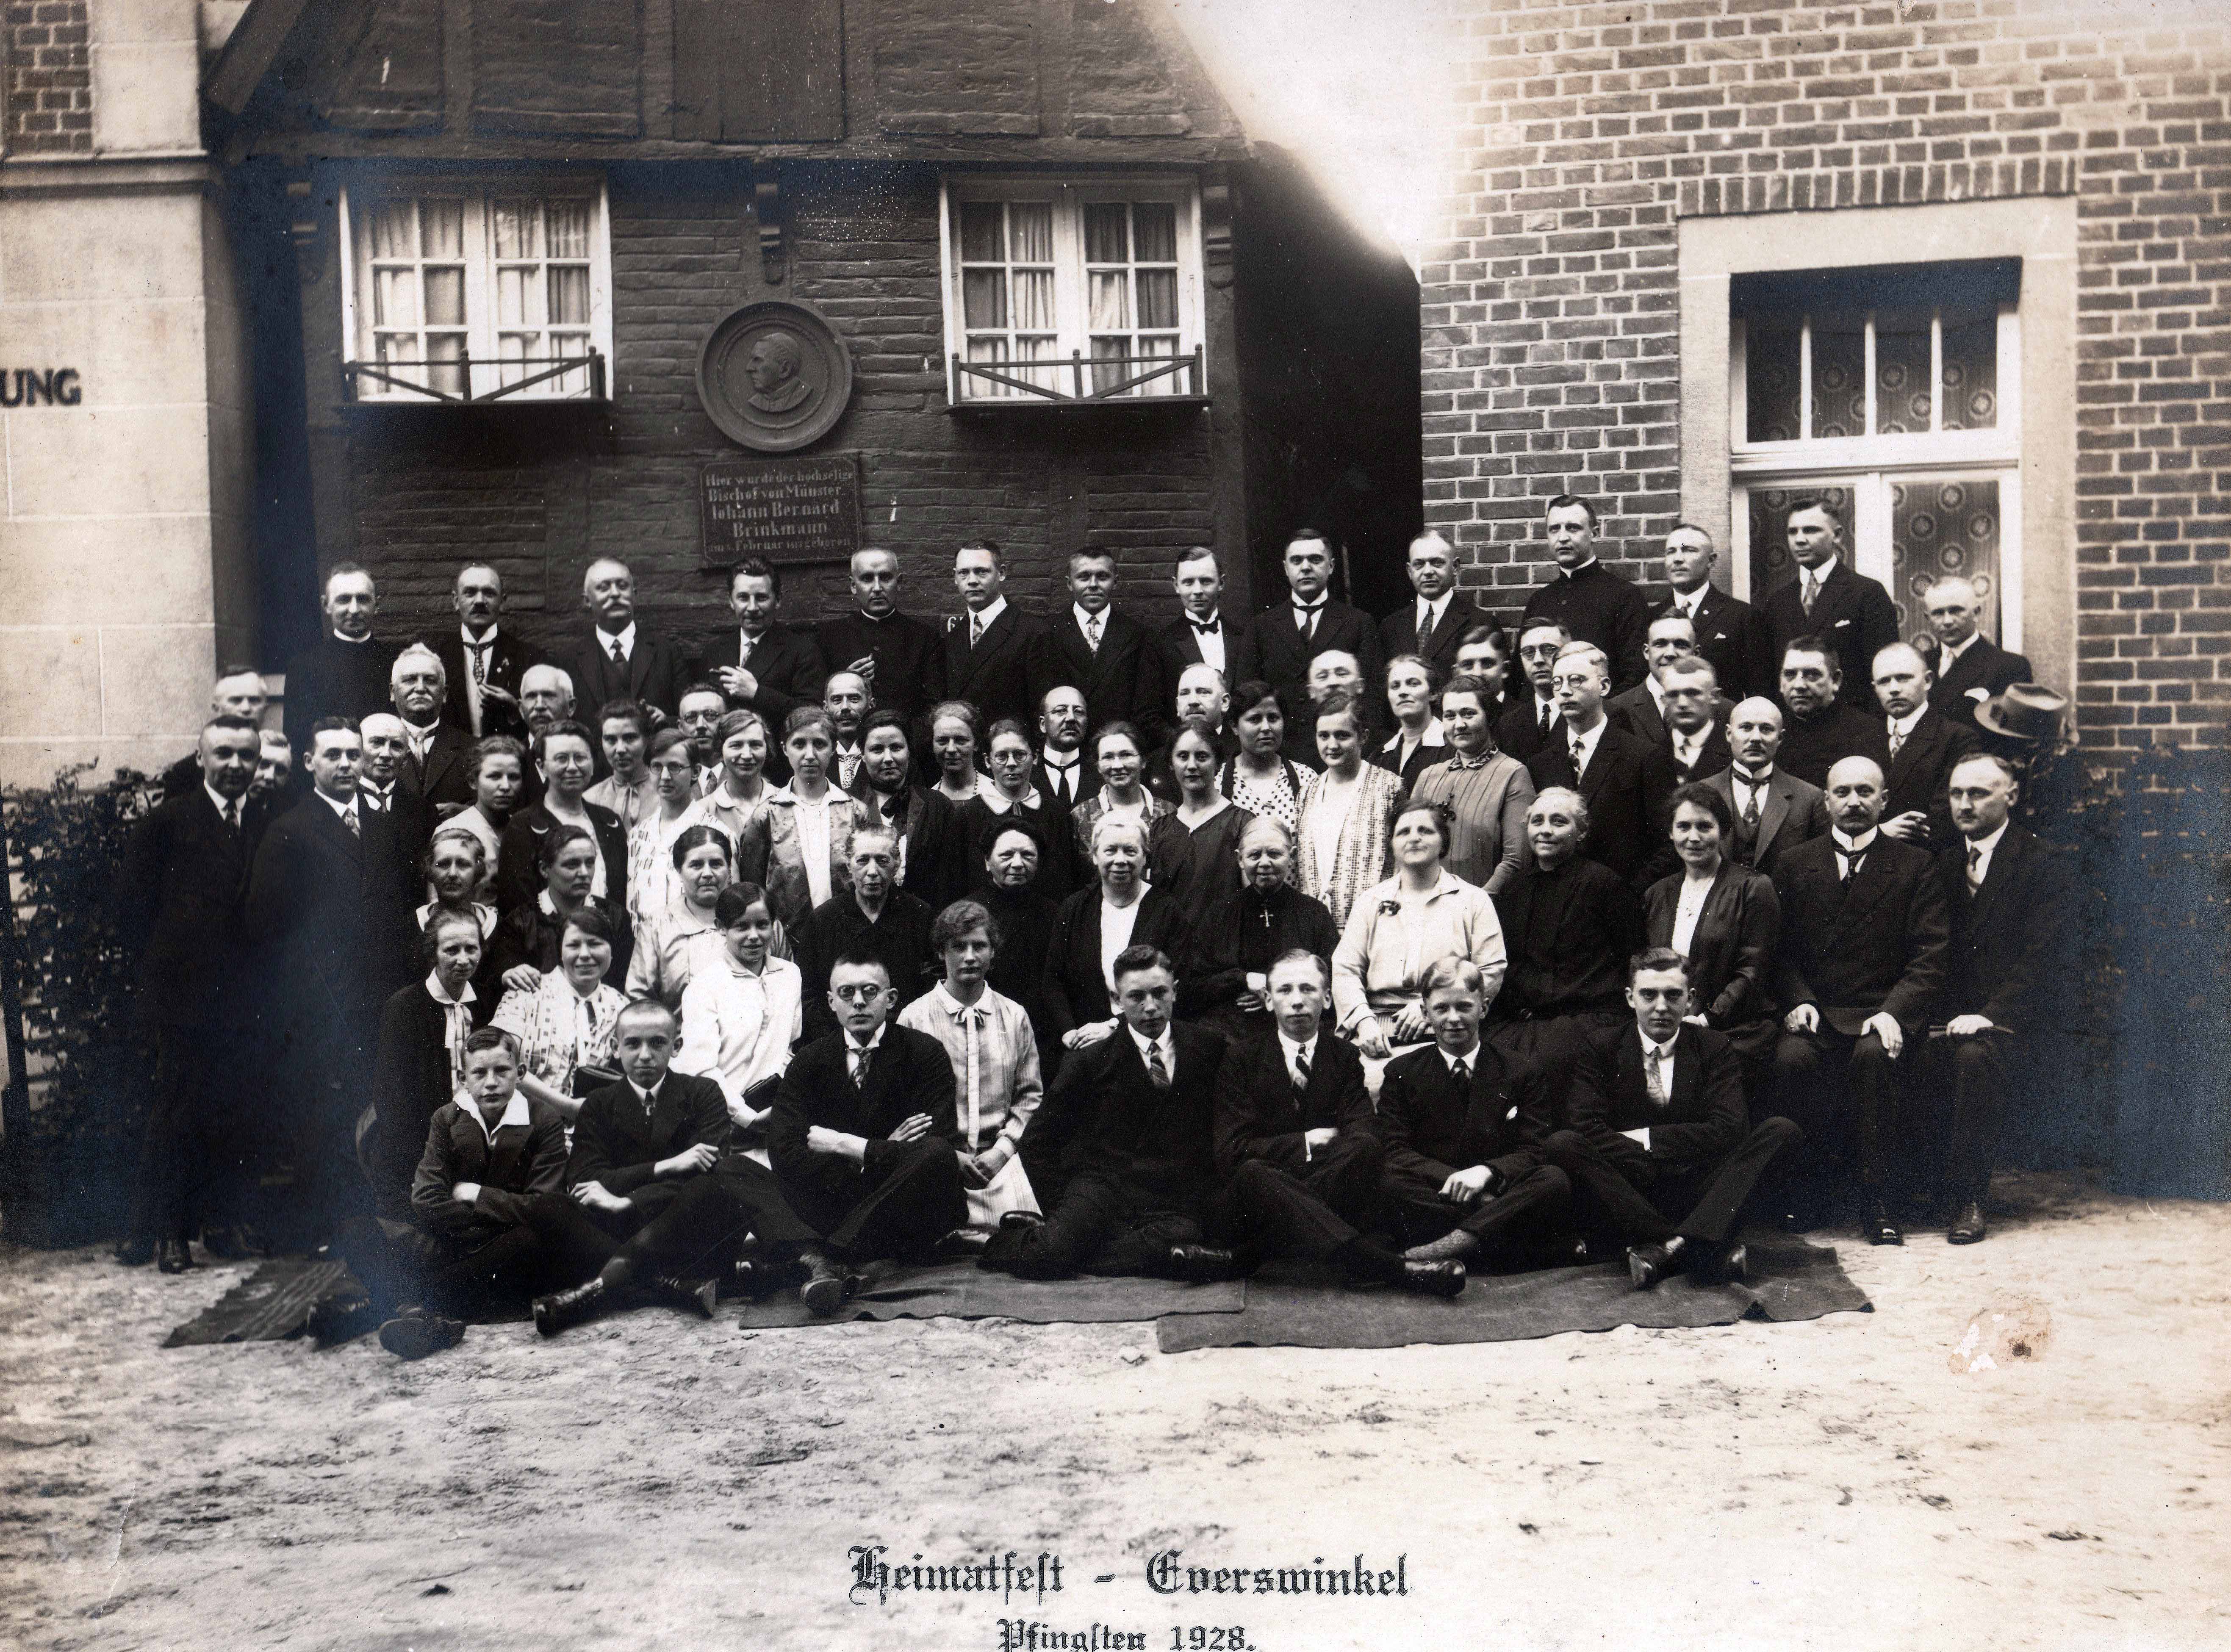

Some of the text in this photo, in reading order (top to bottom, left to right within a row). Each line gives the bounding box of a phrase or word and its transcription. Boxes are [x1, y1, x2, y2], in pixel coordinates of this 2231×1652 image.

[0, 369, 82, 408] UNG
[706, 474, 732, 486] Hier
[735, 472, 773, 484] wurde
[776, 471, 794, 482] der
[708, 484, 841, 502] Bischof von Münster
[771, 499, 840, 518] Bernard
[733, 521, 827, 538] Brinkmann
